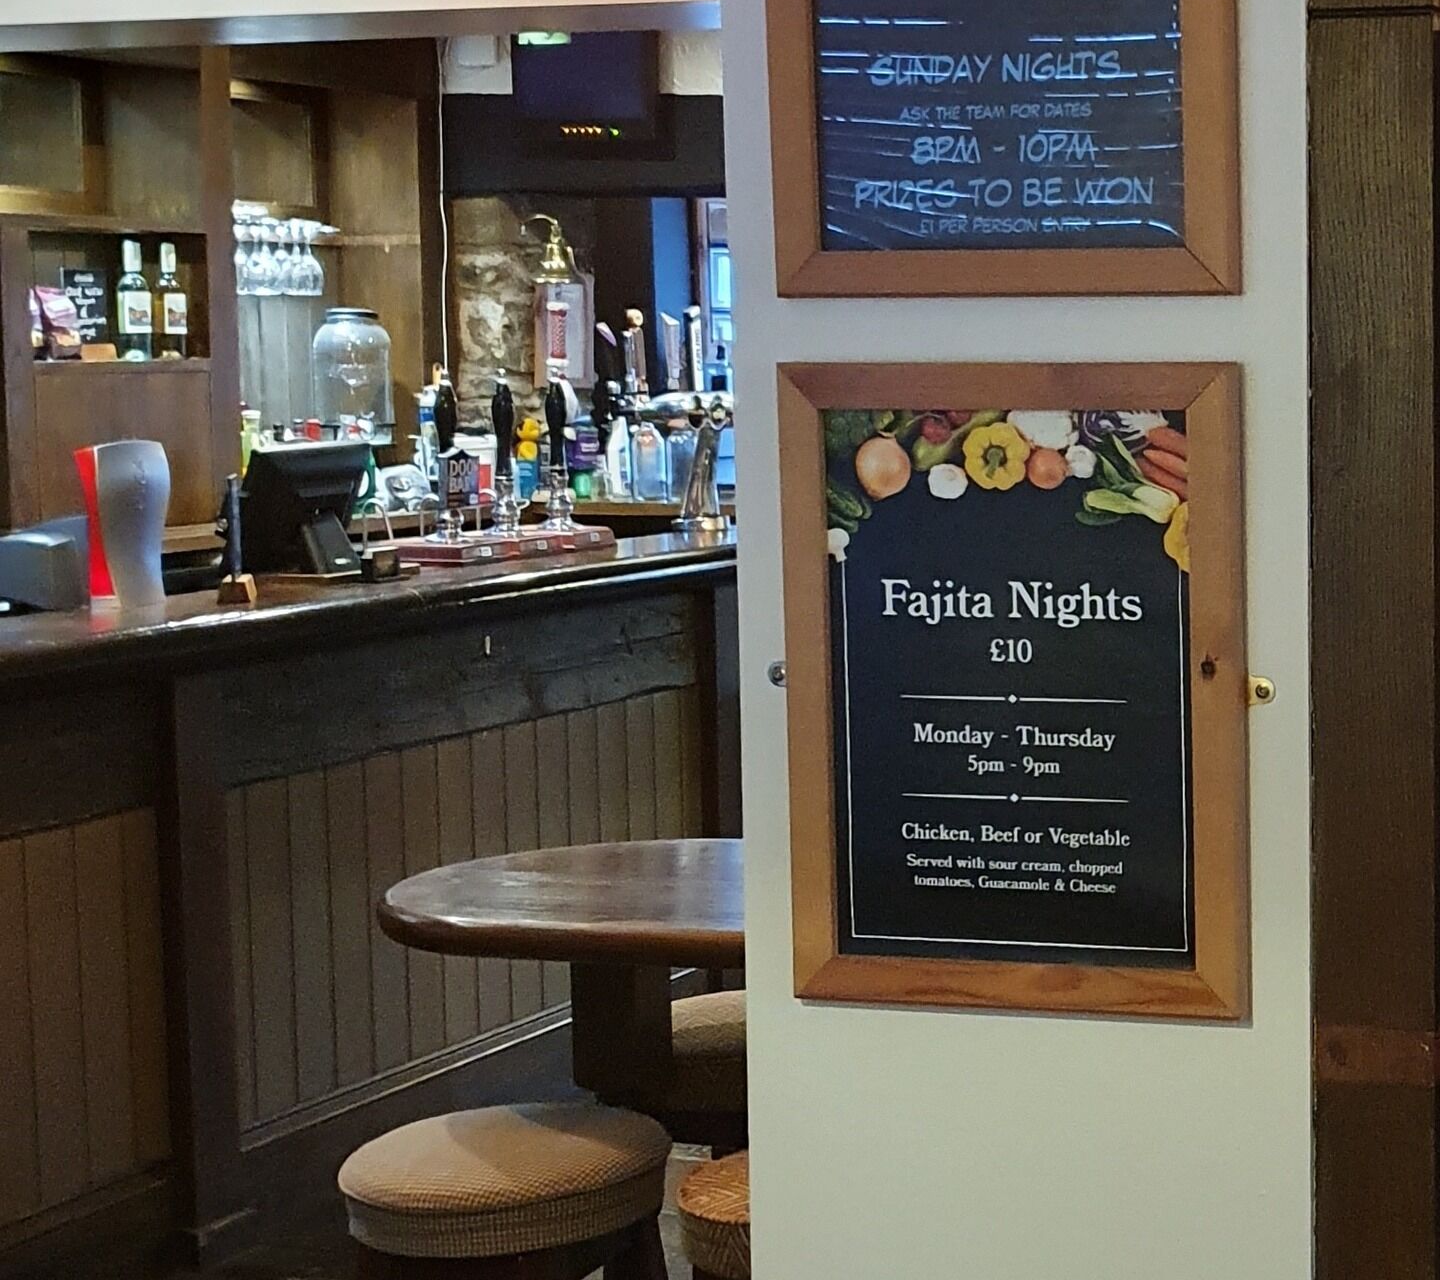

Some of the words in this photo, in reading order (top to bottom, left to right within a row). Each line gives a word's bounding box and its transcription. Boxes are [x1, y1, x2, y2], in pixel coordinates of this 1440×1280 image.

[869, 54, 992, 86] SUNDAY
[899, 107, 930, 122] ASK
[935, 105, 961, 121] THE
[965, 103, 1005, 121] TEAM
[1009, 103, 1041, 119] FOR
[1043, 101, 1092, 118] DATES
[911, 135, 981, 165] 8PM
[1018, 132, 1099, 163] 10PM
[854, 178, 956, 209] PRIZES
[967, 178, 1013, 207] TO
[1022, 177, 1064, 208] BE
[1075, 176, 1155, 207] WON
[937, 217, 967, 234] PER
[972, 217, 1038, 234] PERSON
[879, 578, 994, 625] Fajita
[1007, 581, 1144, 628] Nights
[989, 638, 1034, 664] £10
[912, 722, 995, 748] Monday
[1015, 725, 1117, 751] Thursday
[967, 754, 1005, 773] 5pm
[1022, 755, 1061, 776] 9pm
[901, 822, 975, 844] Chicken,
[980, 824, 1021, 843] Beef
[1023, 830, 1044, 844] or
[1048, 827, 1131, 849] Vegetable
[906, 852, 953, 869] Served
[956, 855, 985, 870] with
[988, 858, 1018, 871] sour
[1021, 861, 1066, 874] cream,
[1068, 860, 1124, 877] chopped
[913, 874, 975, 889] tomatoes,
[978, 875, 1050, 891] Guacamole
[1053, 878, 1066, 892] &
[1069, 878, 1118, 894] Cheese
